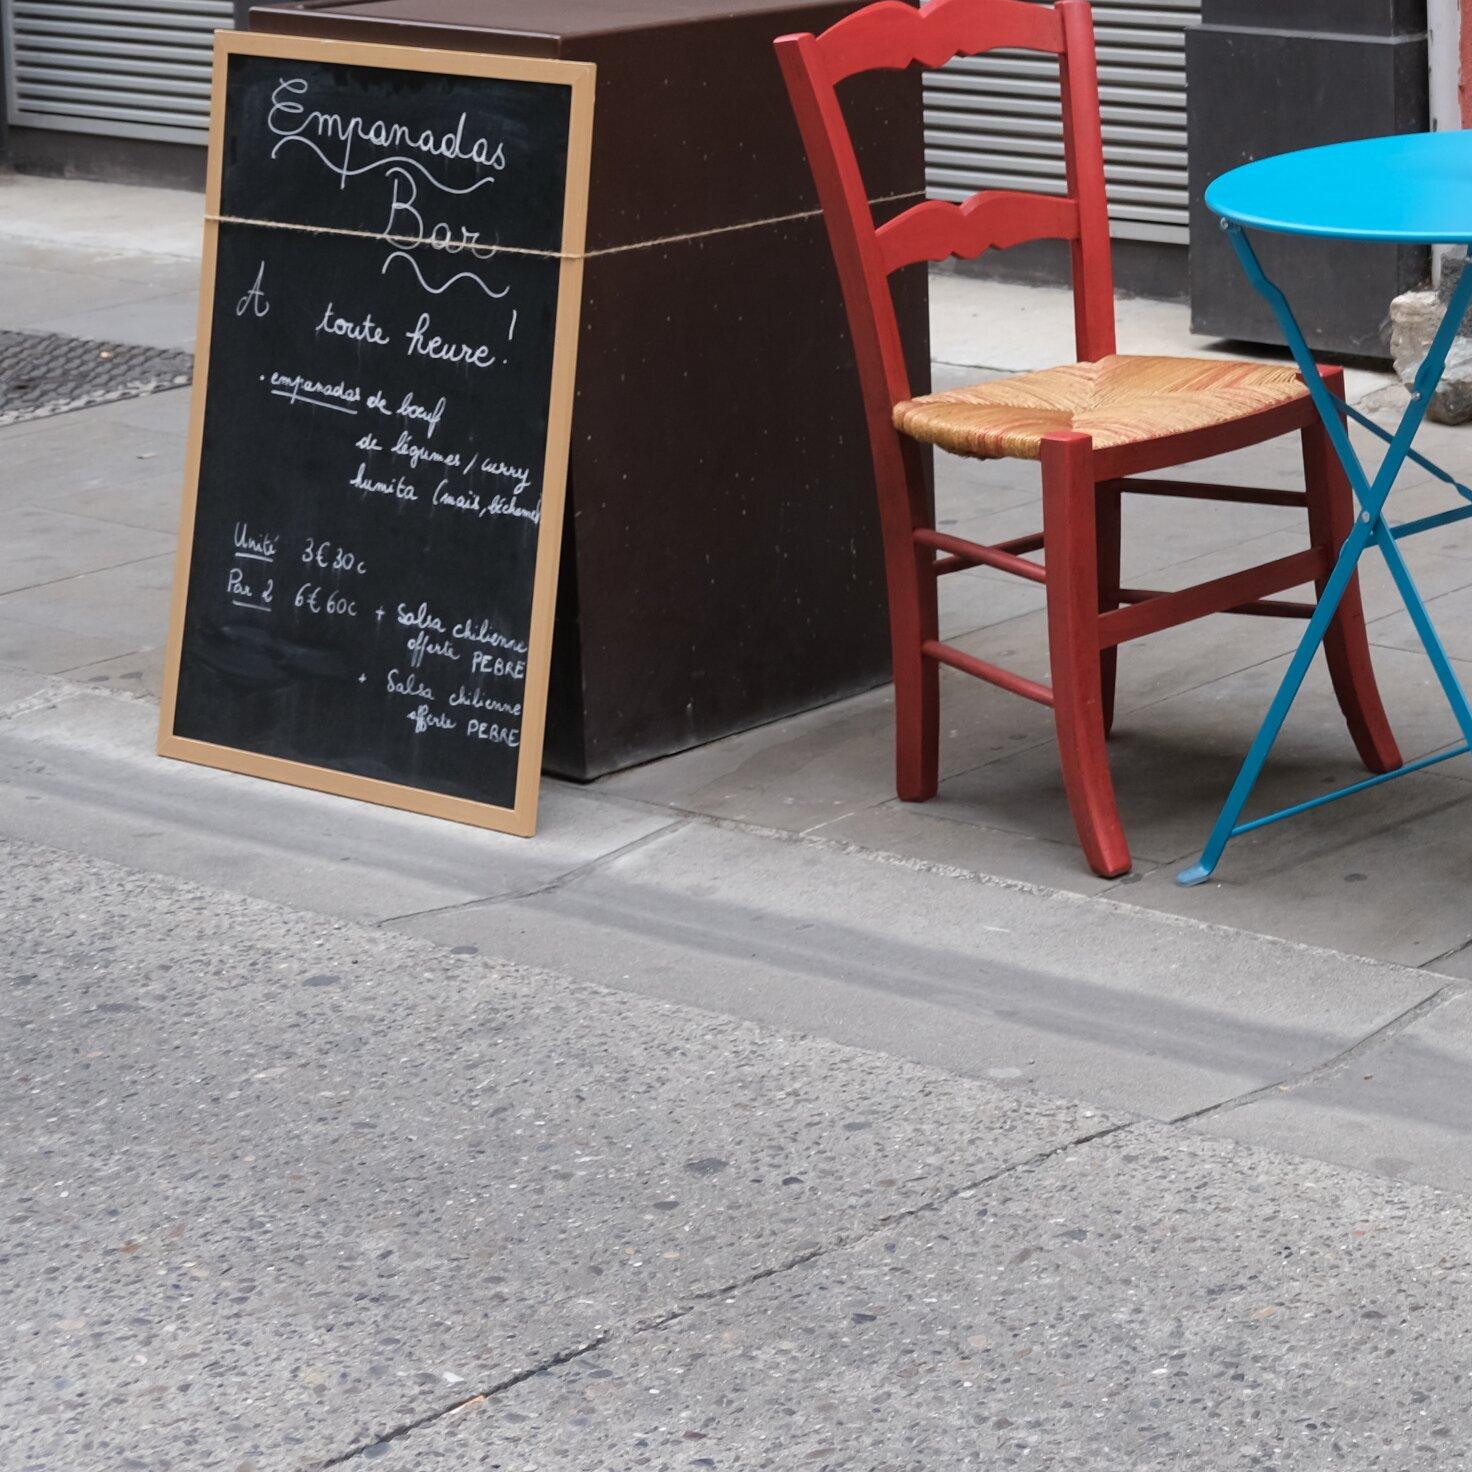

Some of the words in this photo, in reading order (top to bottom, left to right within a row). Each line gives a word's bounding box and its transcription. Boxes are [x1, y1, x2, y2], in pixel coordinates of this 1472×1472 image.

[267, 77, 507, 190] Empanadas
[384, 166, 499, 260] Bar
[236, 260, 270, 317] A
[315, 302, 390, 344] toute
[366, 390, 393, 416] de
[356, 433, 383, 451] de
[234, 521, 280, 556] Unité
[226, 567, 253, 597] Par
[261, 578, 274, 603] 2
[397, 602, 447, 634] Salsa
[471, 650, 527, 680] PEBRE
[386, 669, 436, 701] Salsa
[466, 718, 521, 748] PEBRE
